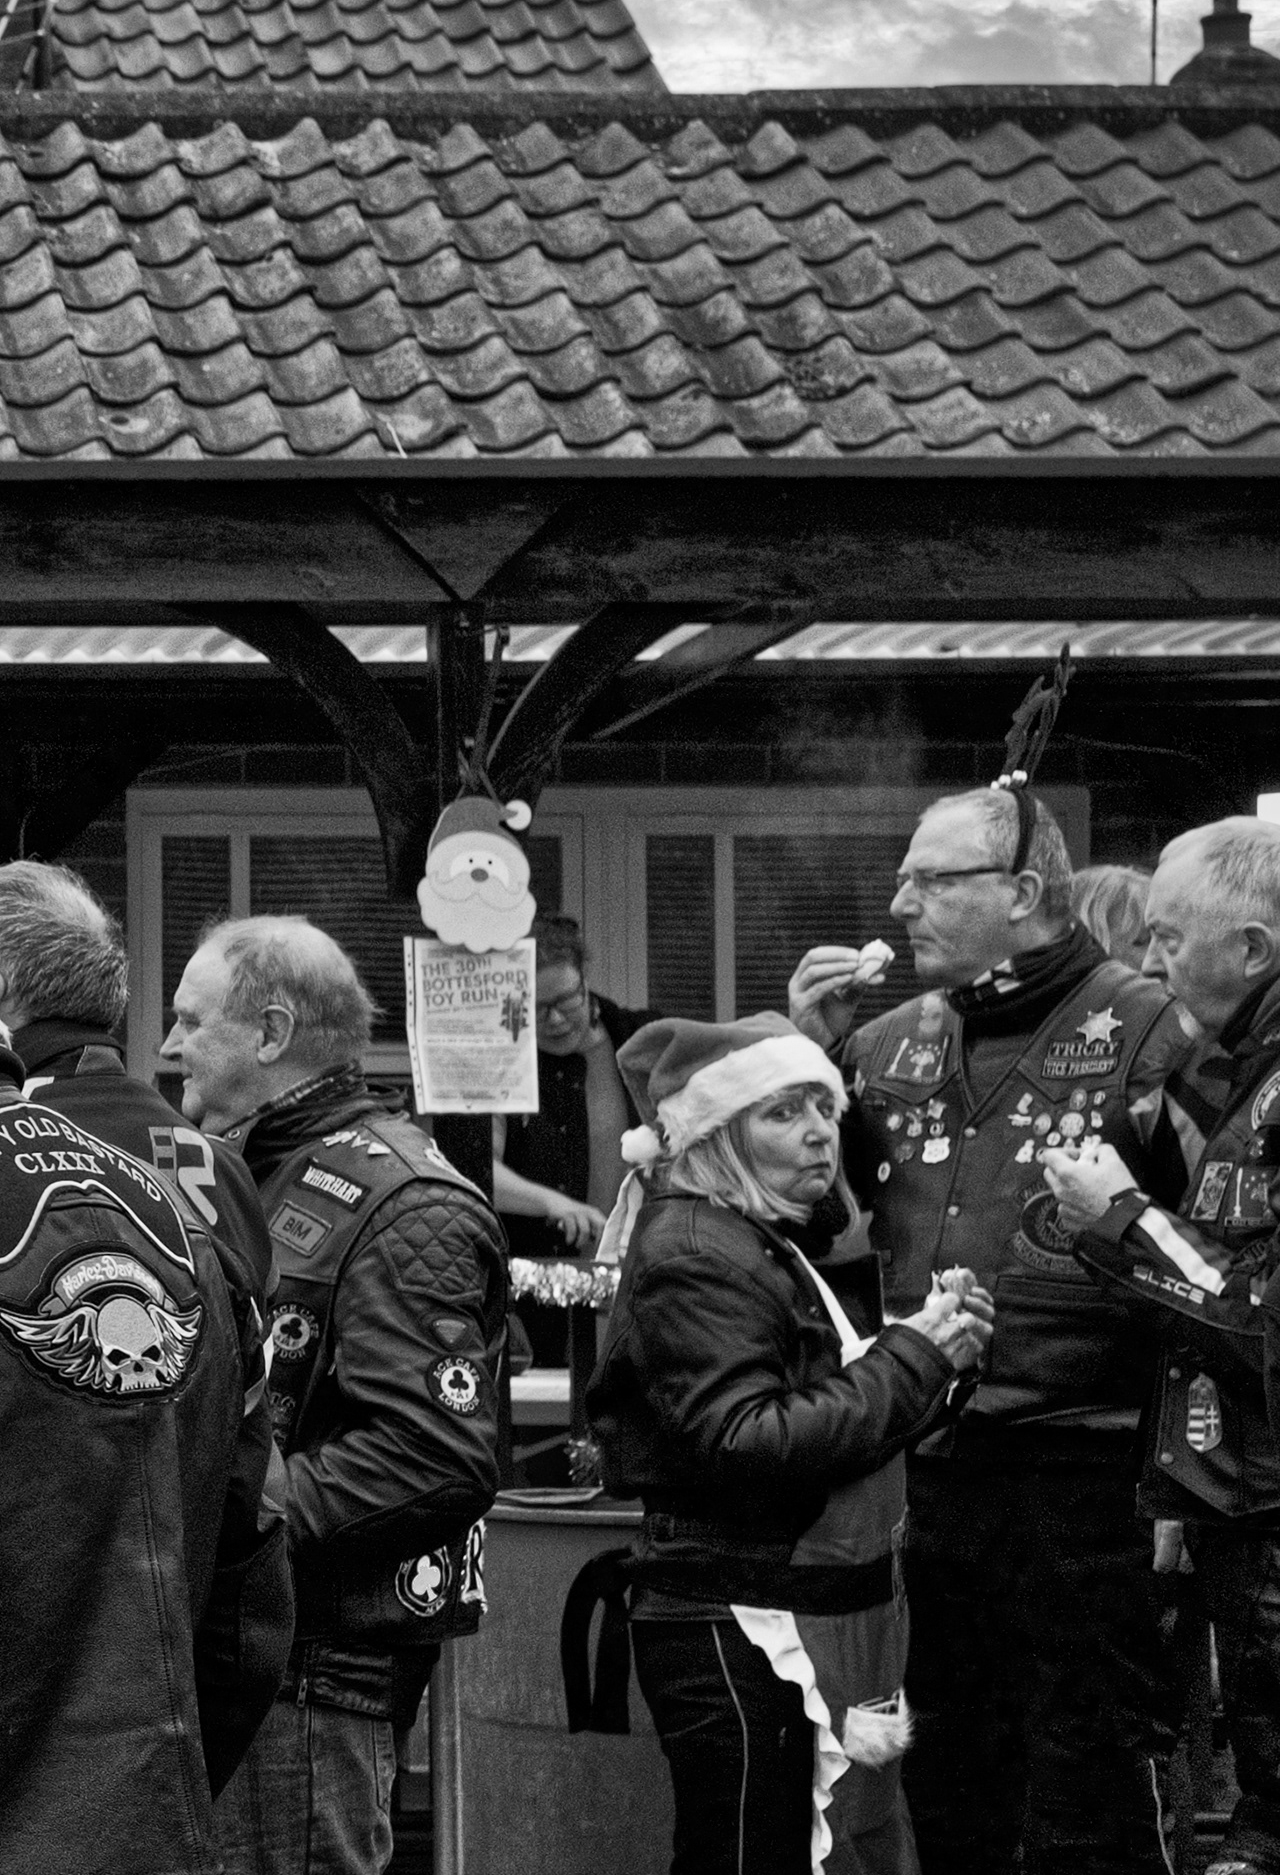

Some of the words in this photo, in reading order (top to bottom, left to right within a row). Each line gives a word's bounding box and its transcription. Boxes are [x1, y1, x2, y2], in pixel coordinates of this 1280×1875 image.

[421, 961, 450, 977] THE
[423, 970, 528, 992] BOTTESFORD
[424, 992, 454, 1007] TOY
[461, 988, 498, 1004] RUN
[1052, 1041, 1119, 1057] TRICKY
[1047, 1060, 1067, 1076] VICE
[14, 1116, 60, 1139] OLD
[59, 1122, 162, 1202] BASTARD
[14, 1151, 105, 1175] CLXXX
[282, 1217, 312, 1240] BIM
[438, 1392, 479, 1412] LONDON
